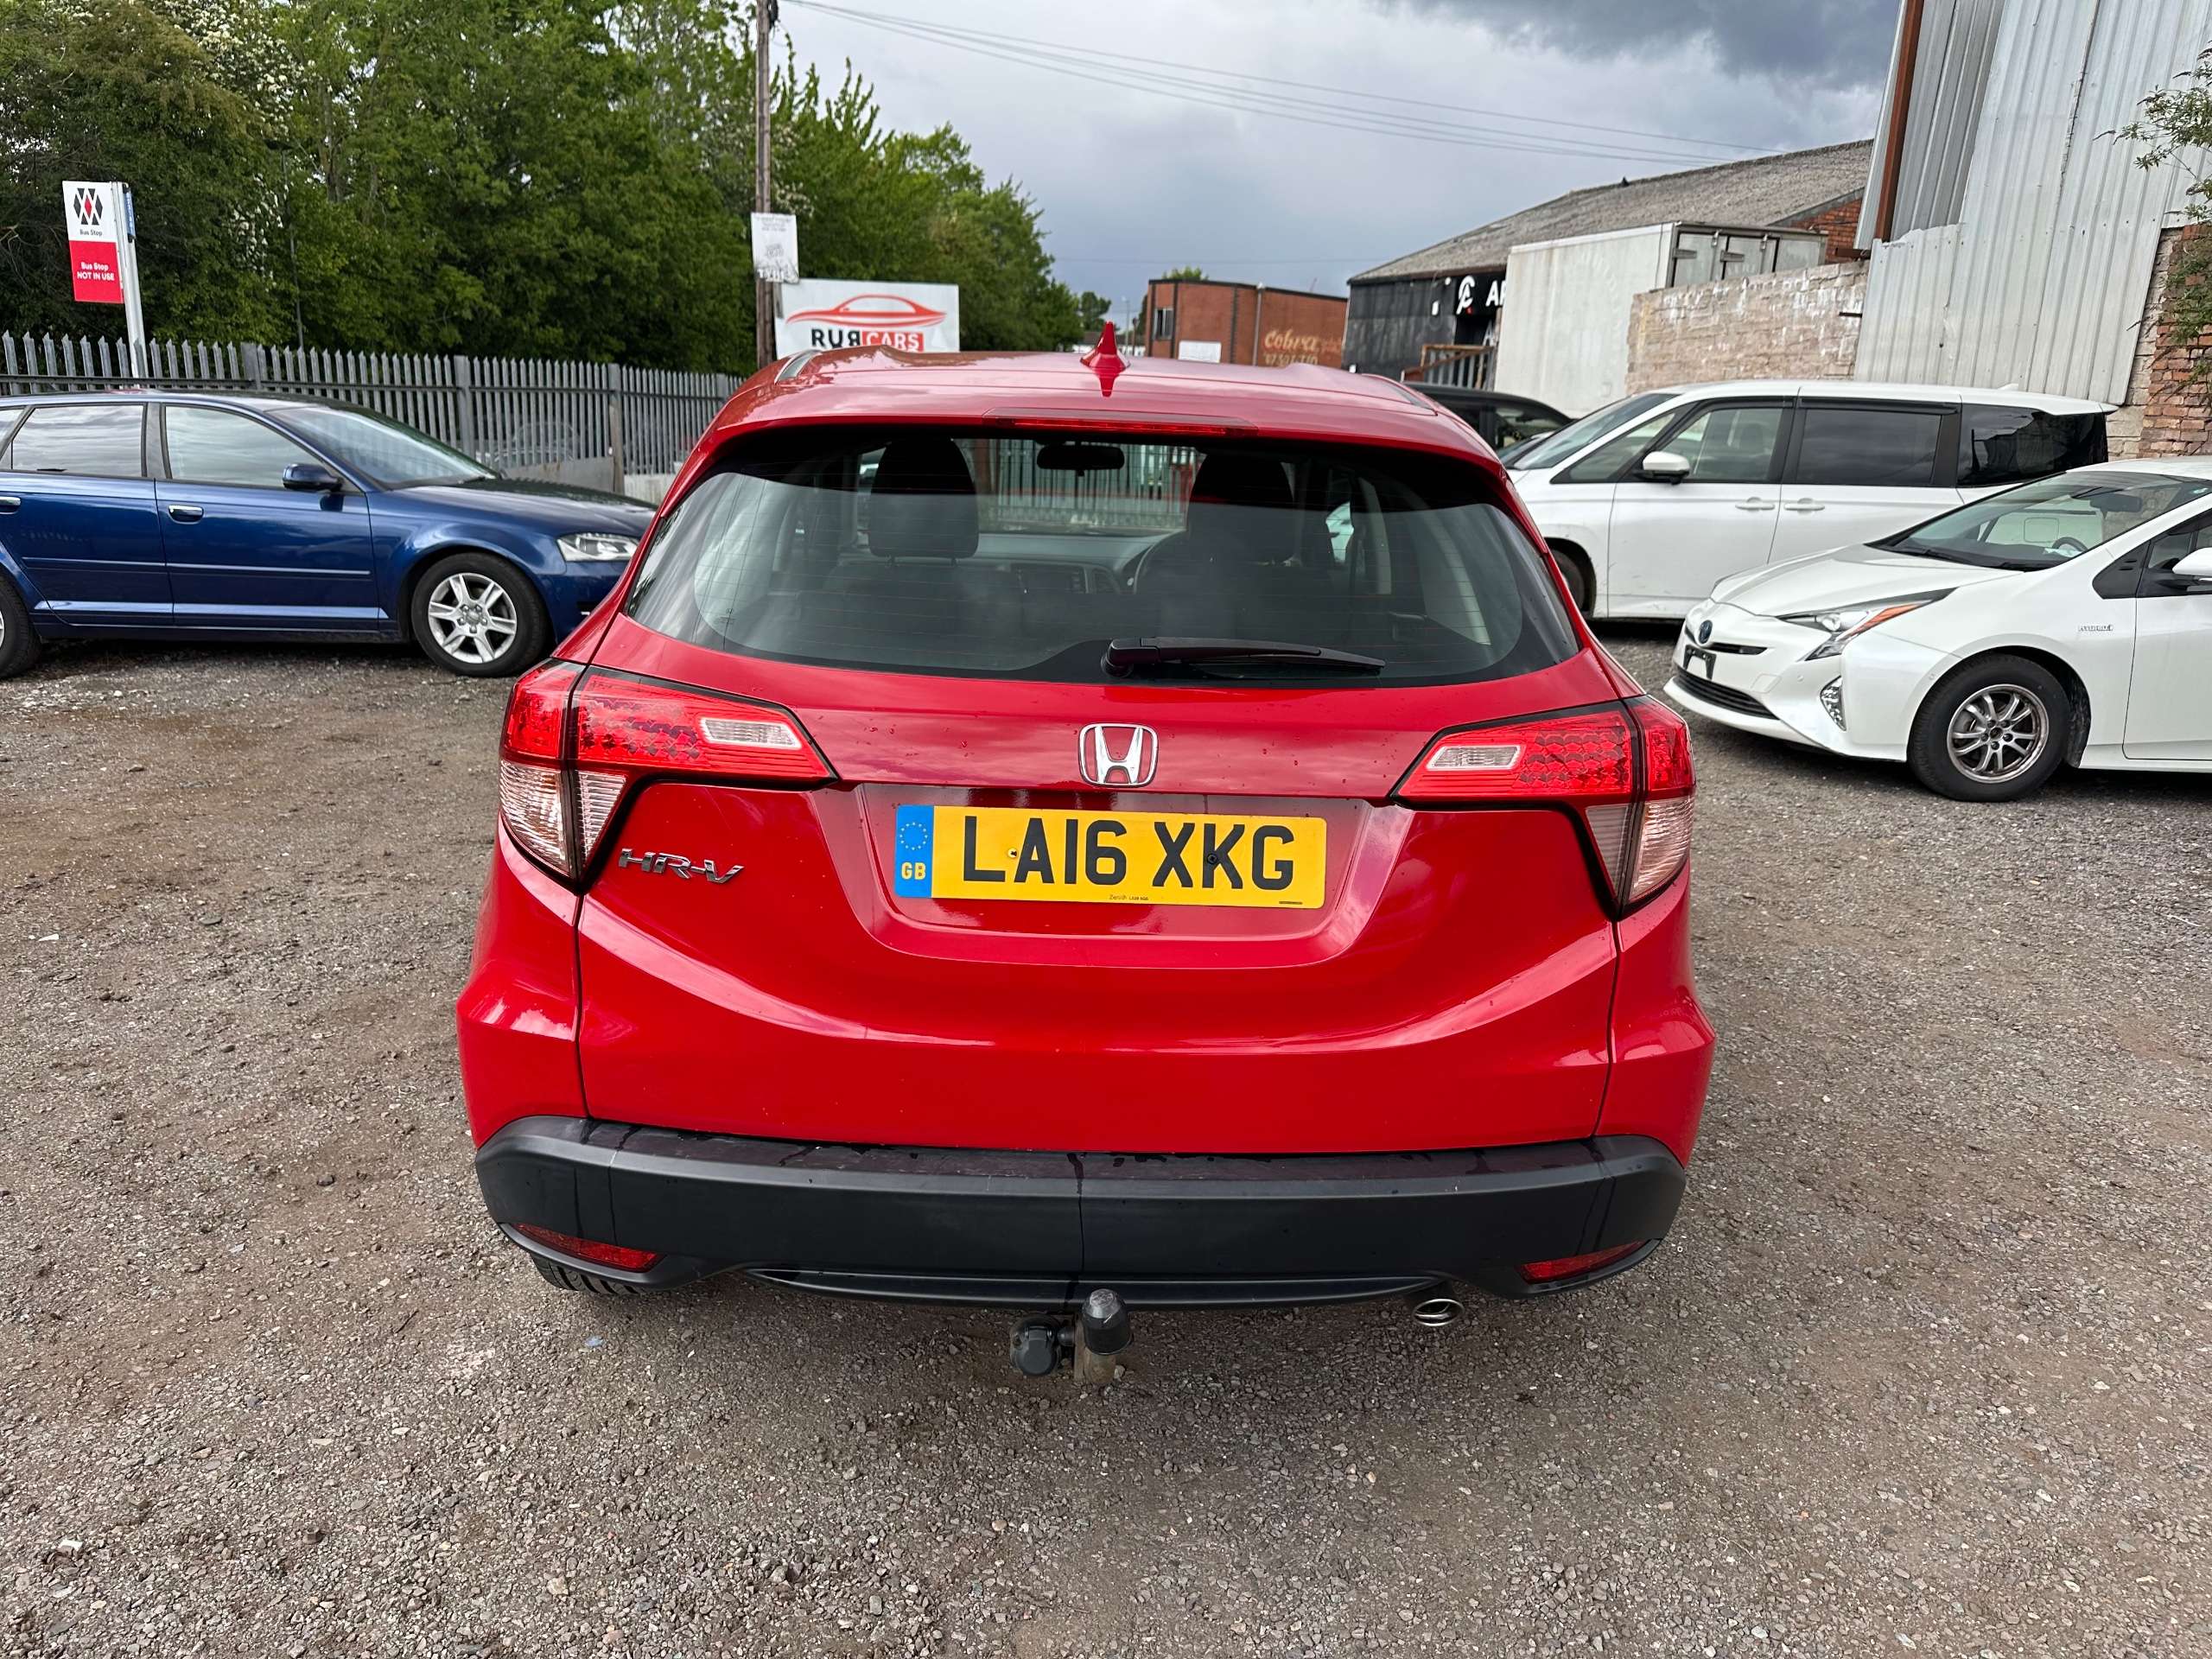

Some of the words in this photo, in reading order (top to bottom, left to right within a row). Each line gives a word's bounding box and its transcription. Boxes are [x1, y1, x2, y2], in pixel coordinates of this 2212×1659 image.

[77, 271, 92, 280] NOT
[92, 272, 101, 281] IN
[93, 263, 108, 271] Stop
[1264, 328, 1319, 353] Cobra
[963, 815, 1128, 886] LA16
[1152, 821, 1296, 891] XKG
[618, 848, 745, 884] HR-V
[901, 861, 926, 880] GB
